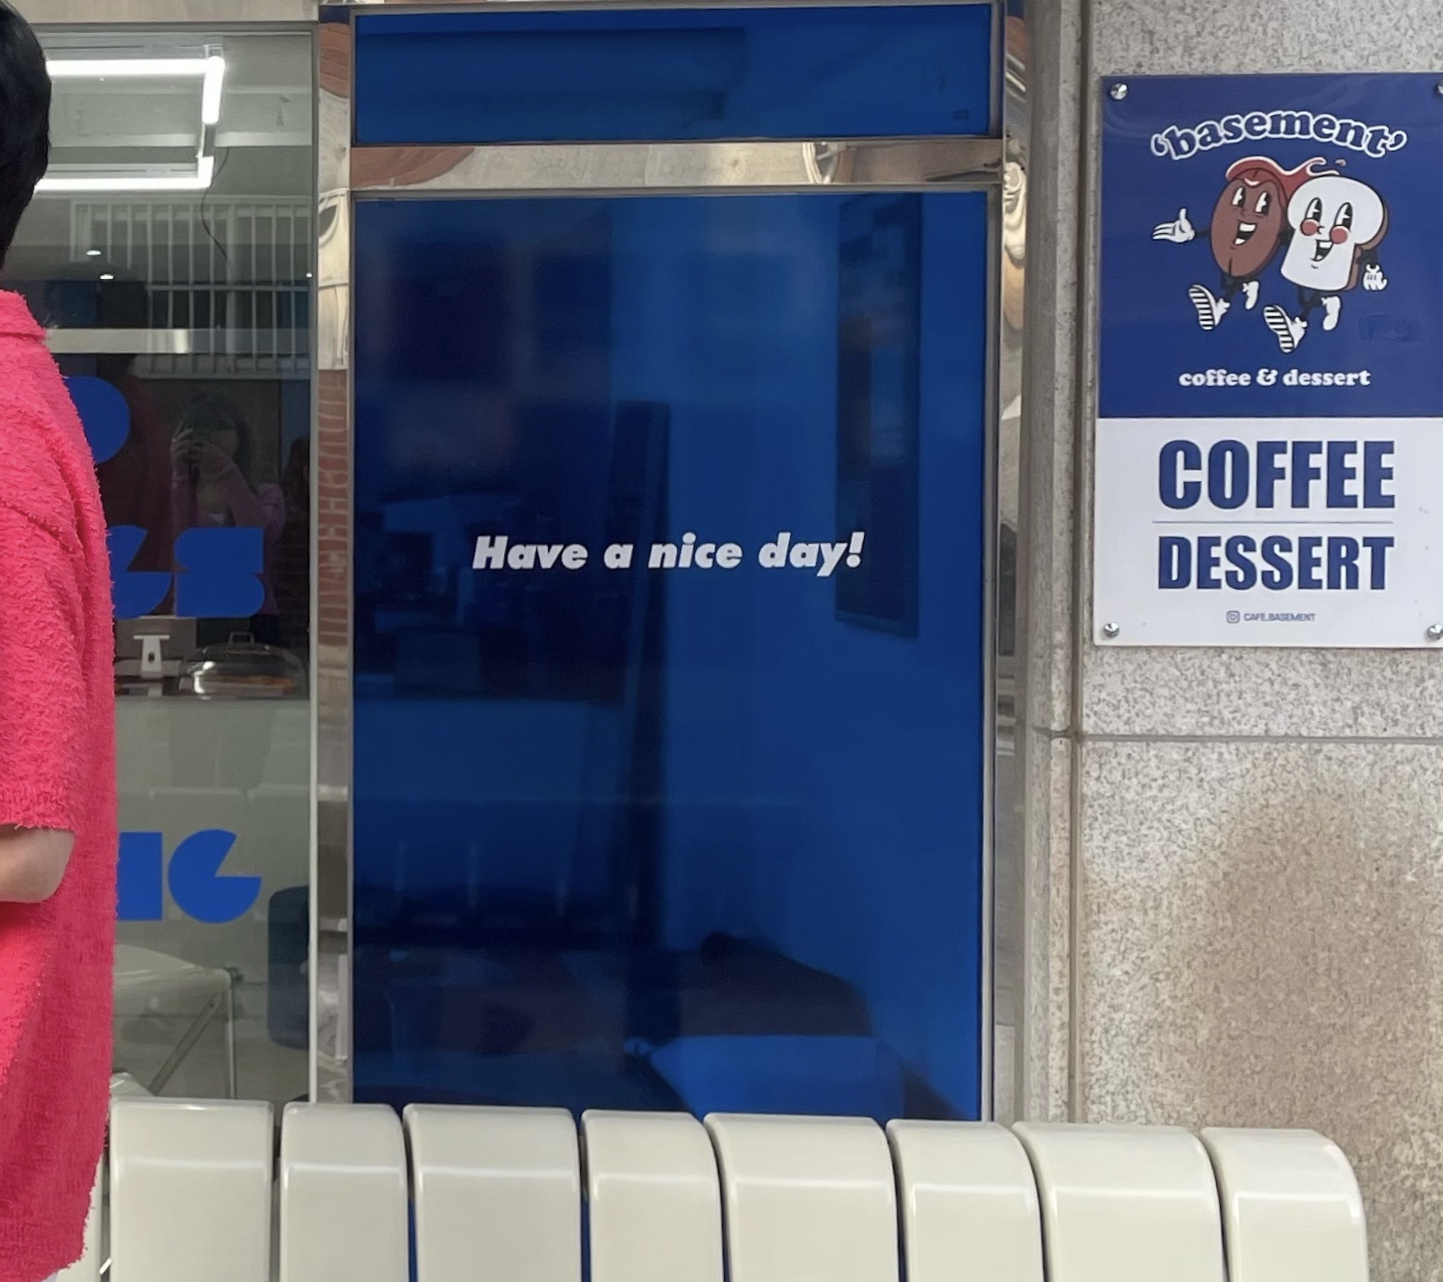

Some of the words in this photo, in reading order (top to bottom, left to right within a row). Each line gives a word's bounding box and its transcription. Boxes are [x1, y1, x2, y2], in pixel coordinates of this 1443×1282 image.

[1178, 368, 1251, 387] coffee
[1256, 368, 1278, 386] &
[1282, 368, 1371, 387] dessert
[1158, 439, 1395, 510] COFFEE
[472, 535, 588, 570] Have
[604, 543, 633, 569] a
[648, 532, 742, 569] nice
[758, 531, 865, 577] day!
[1158, 535, 1395, 591] DESSERT
